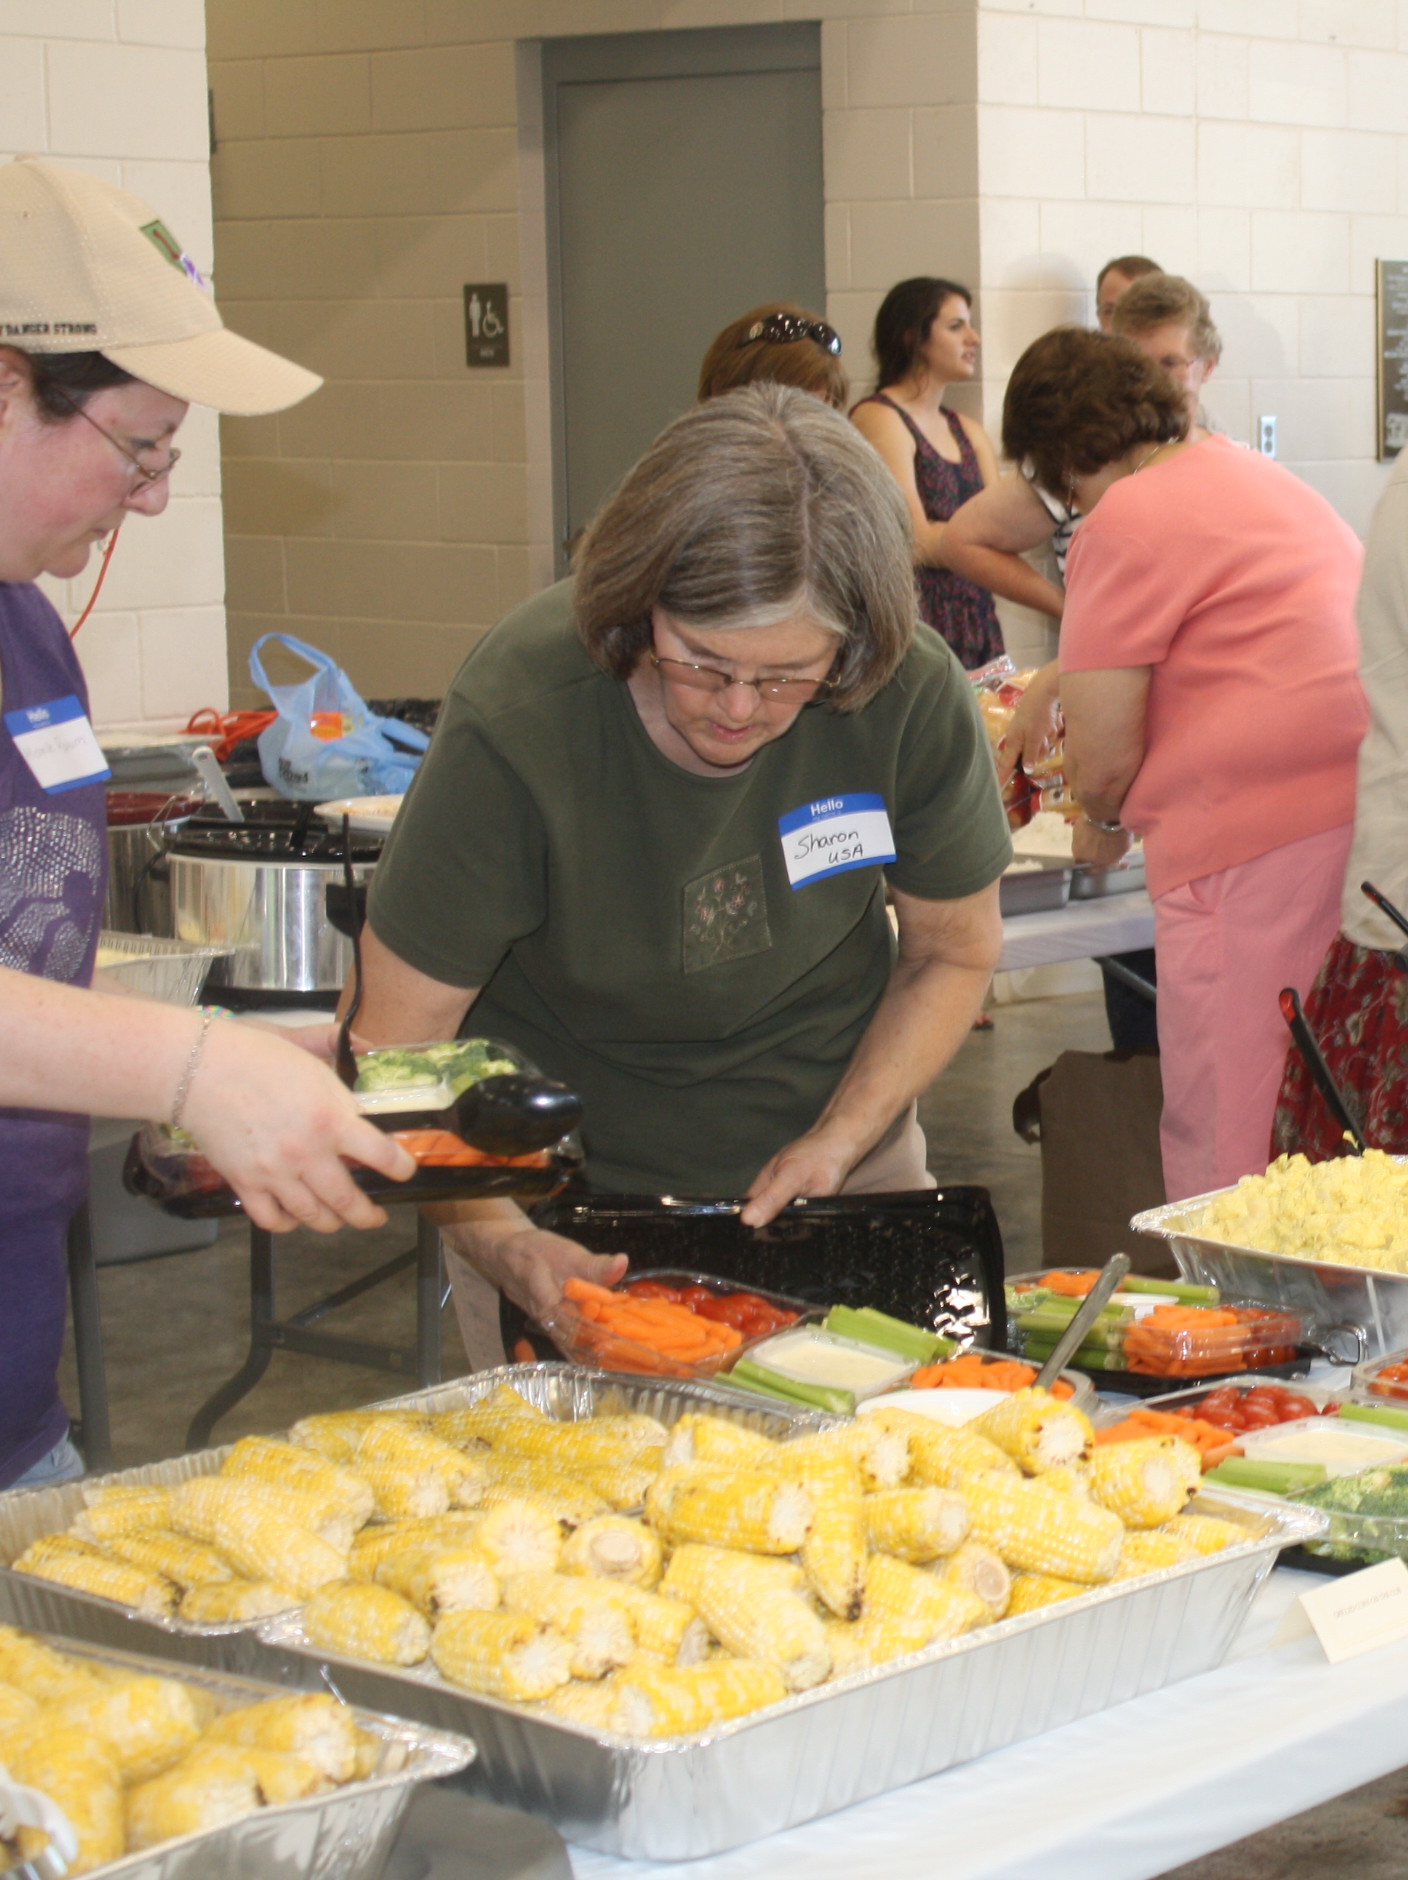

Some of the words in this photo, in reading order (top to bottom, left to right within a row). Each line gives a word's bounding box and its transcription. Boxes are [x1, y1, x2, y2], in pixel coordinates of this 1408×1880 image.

[53, 323, 97, 335] STRONG
[810, 799, 844, 817] Hello
[794, 831, 859, 860] Sharon
[828, 844, 863, 864] USA
